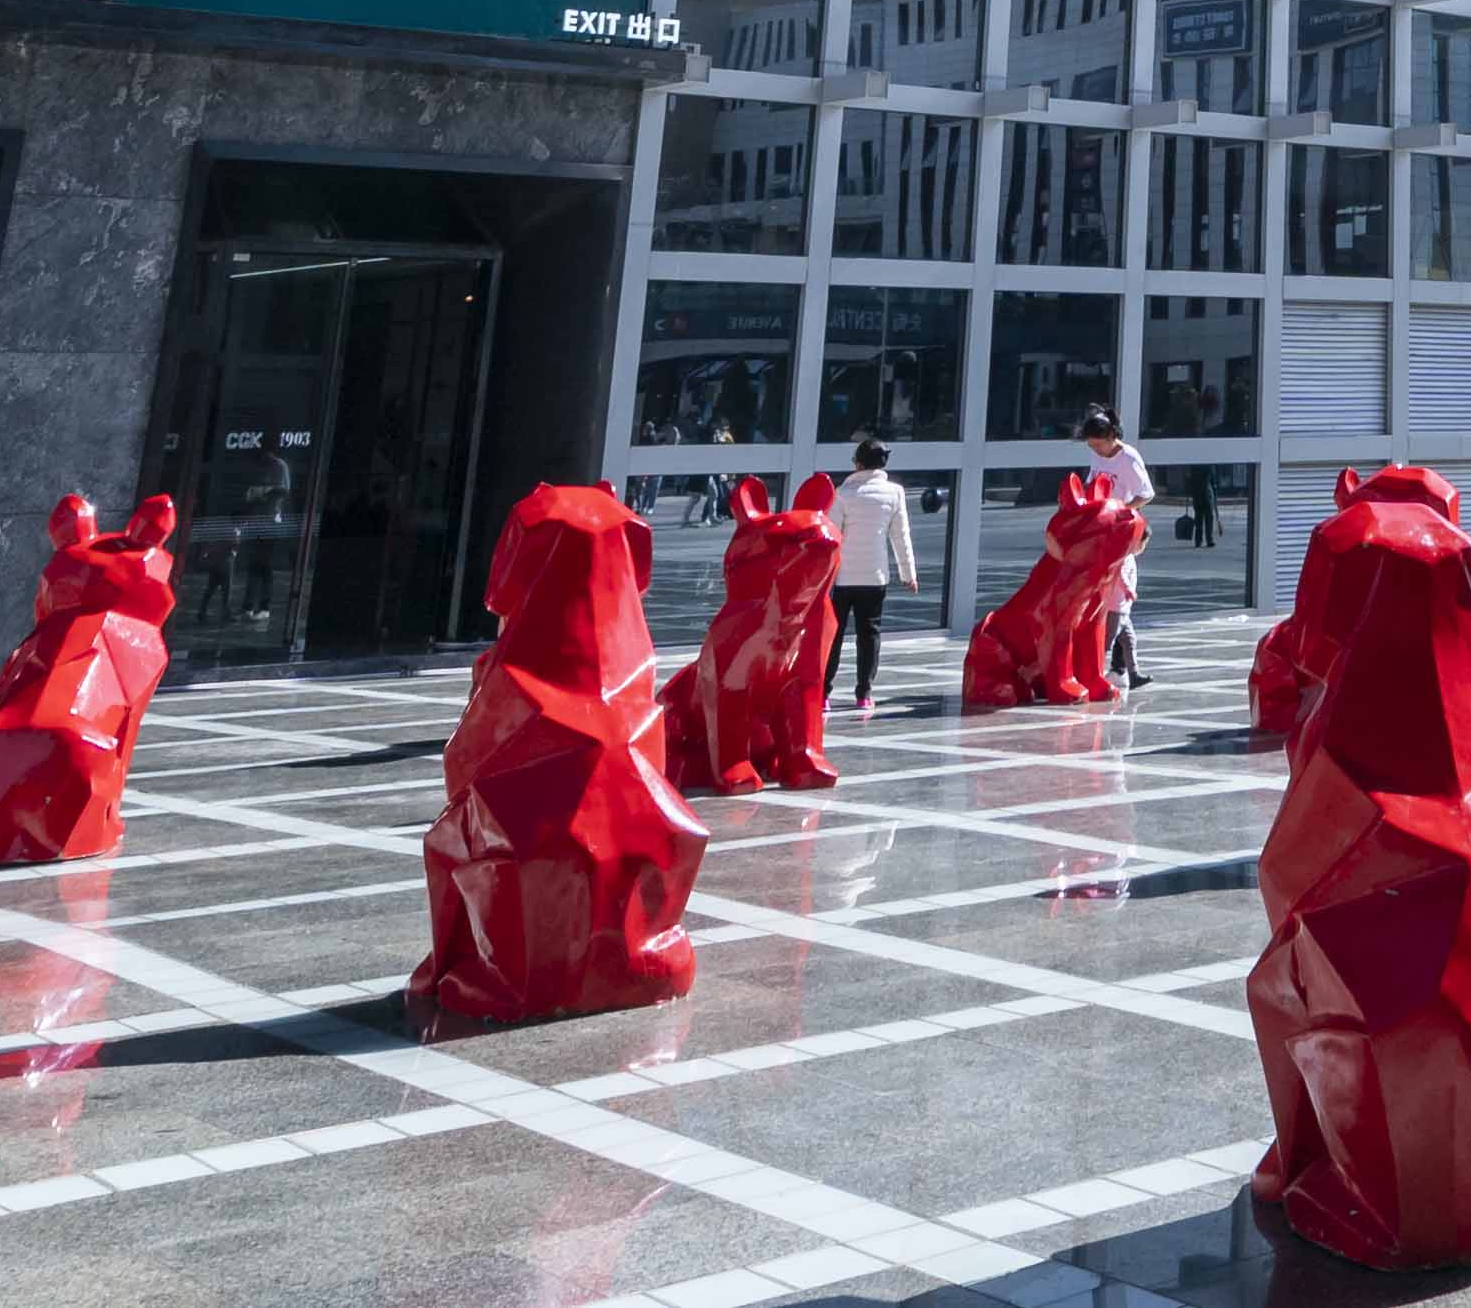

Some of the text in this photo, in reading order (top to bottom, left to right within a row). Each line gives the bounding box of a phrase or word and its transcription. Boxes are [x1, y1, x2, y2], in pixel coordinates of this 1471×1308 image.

[562, 8, 680, 44] EXIT 出口
[225, 431, 312, 449] CGK 1903
